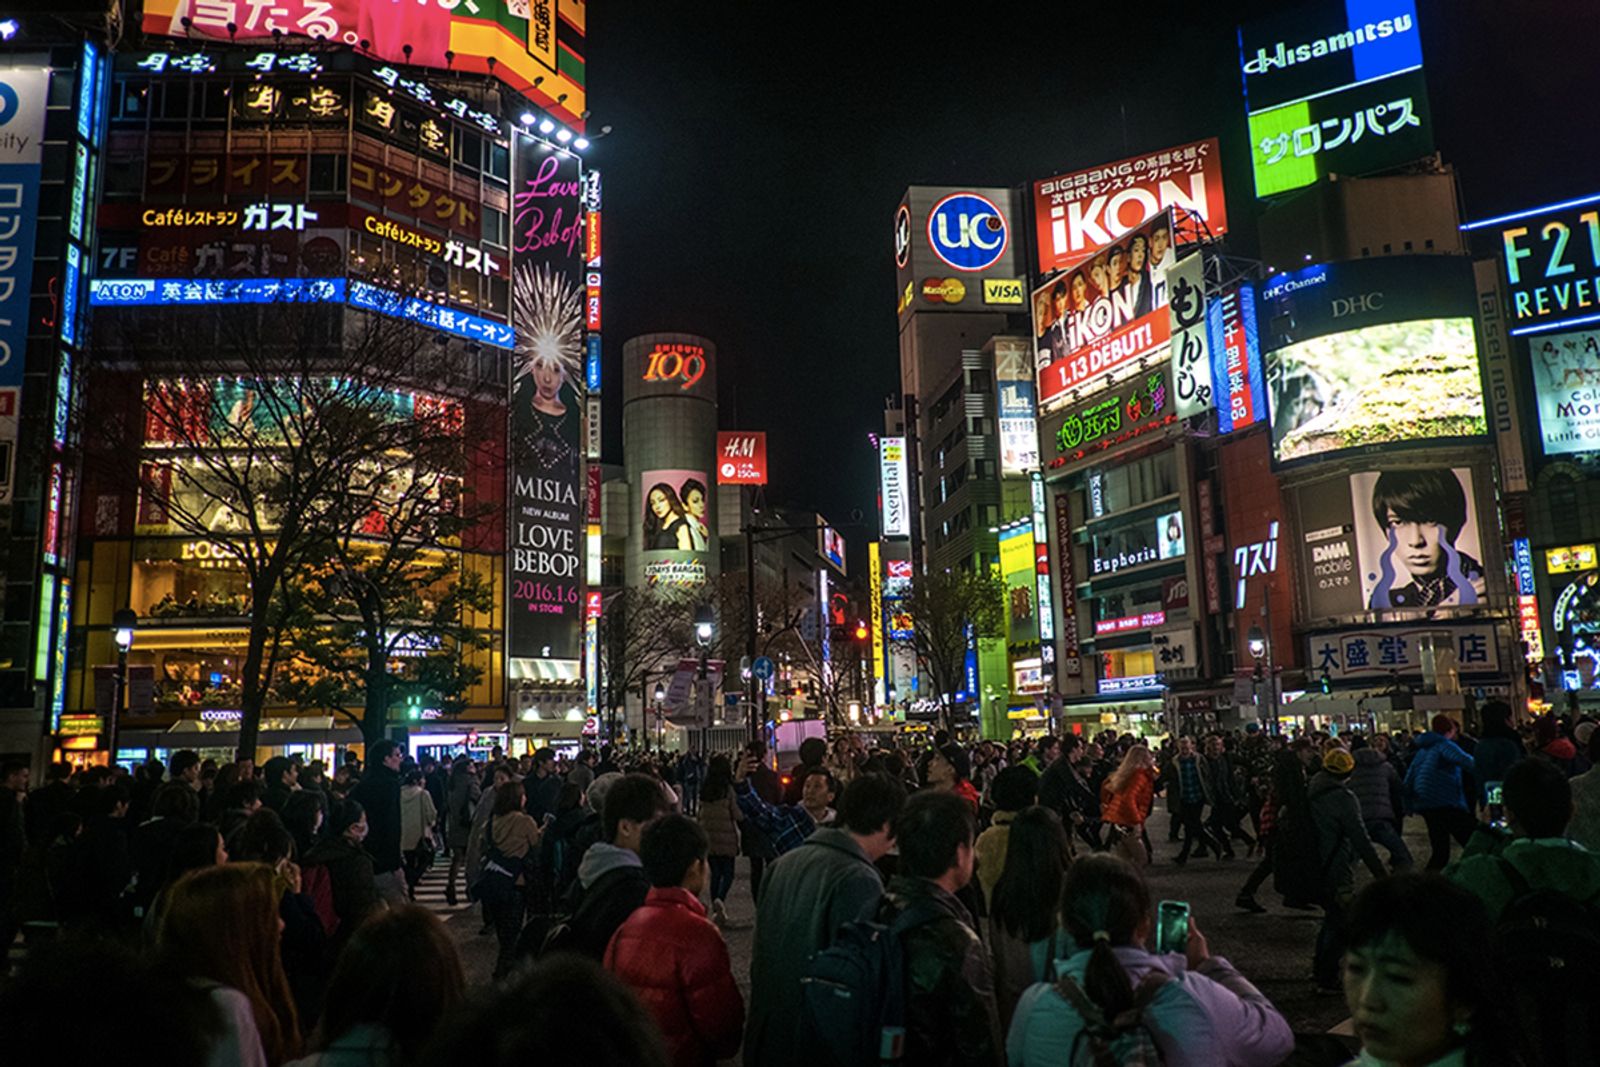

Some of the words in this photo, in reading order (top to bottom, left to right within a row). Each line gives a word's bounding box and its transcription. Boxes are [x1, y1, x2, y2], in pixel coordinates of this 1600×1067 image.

[1243, 14, 1413, 74] Hisamitsu
[1260, 98, 1420, 165] サロンパス
[151, 159, 301, 186] プライス
[515, 156, 580, 208] Love
[351, 162, 476, 226] コンタクト
[243, 203, 318, 230] ガスト
[1052, 172, 1209, 256] iKON
[102, 247, 137, 269] 7F
[444, 240, 499, 276] ガスト
[1503, 211, 1600, 284] F21
[101, 284, 146, 298] AEON
[990, 285, 1021, 299] VISA
[1284, 272, 1326, 293] Channel
[1331, 292, 1384, 318] DHC
[1515, 277, 1600, 319] REVE
[1069, 282, 1142, 352] iKON
[1059, 356, 1088, 387] 1.13
[1089, 322, 1153, 373] DEBUT!
[1171, 277, 1211, 406] もんじゃ
[642, 351, 706, 390] 109
[724, 437, 756, 458] H&M
[514, 474, 578, 506] MISIA
[883, 462, 900, 533] Essential
[522, 506, 542, 517] NEW
[543, 511, 570, 522] ALBUM
[518, 522, 574, 552] LOVE
[1313, 541, 1350, 563] DMM
[514, 548, 579, 578] BEBOP
[1094, 547, 1157, 574] Euphoria
[1314, 558, 1352, 577] mobile
[513, 579, 578, 604] 2016.1.6
[528, 603, 538, 612] IN
[540, 604, 564, 614] STORE
[1318, 633, 1487, 672] 大盛堂店
